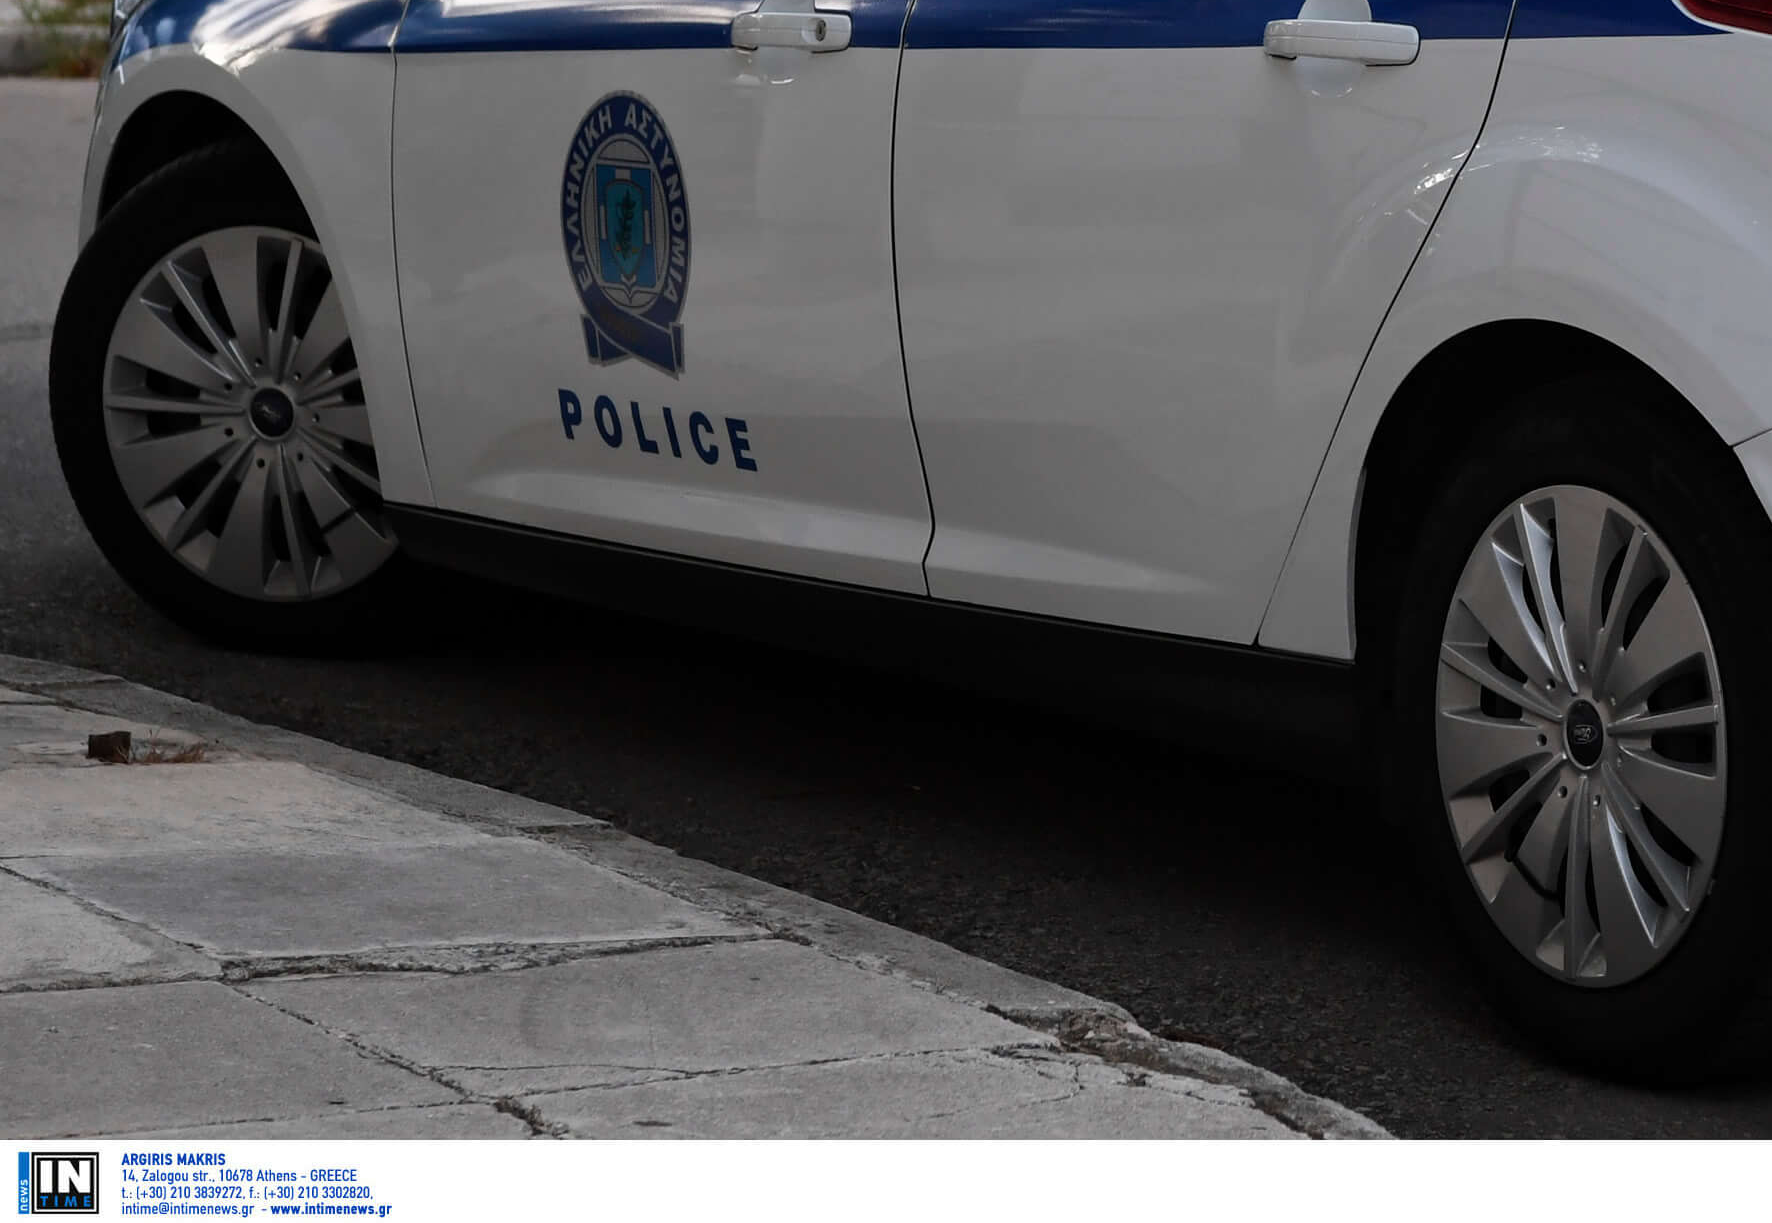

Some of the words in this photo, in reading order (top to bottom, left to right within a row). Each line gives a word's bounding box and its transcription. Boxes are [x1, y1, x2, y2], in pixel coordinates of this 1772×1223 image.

[565, 105, 613, 292] ΕΛΛΗΝΙΚΗ
[623, 102, 686, 304] ΑΣΤΥΝΟΜΙΑ
[558, 388, 758, 472] POLICE
